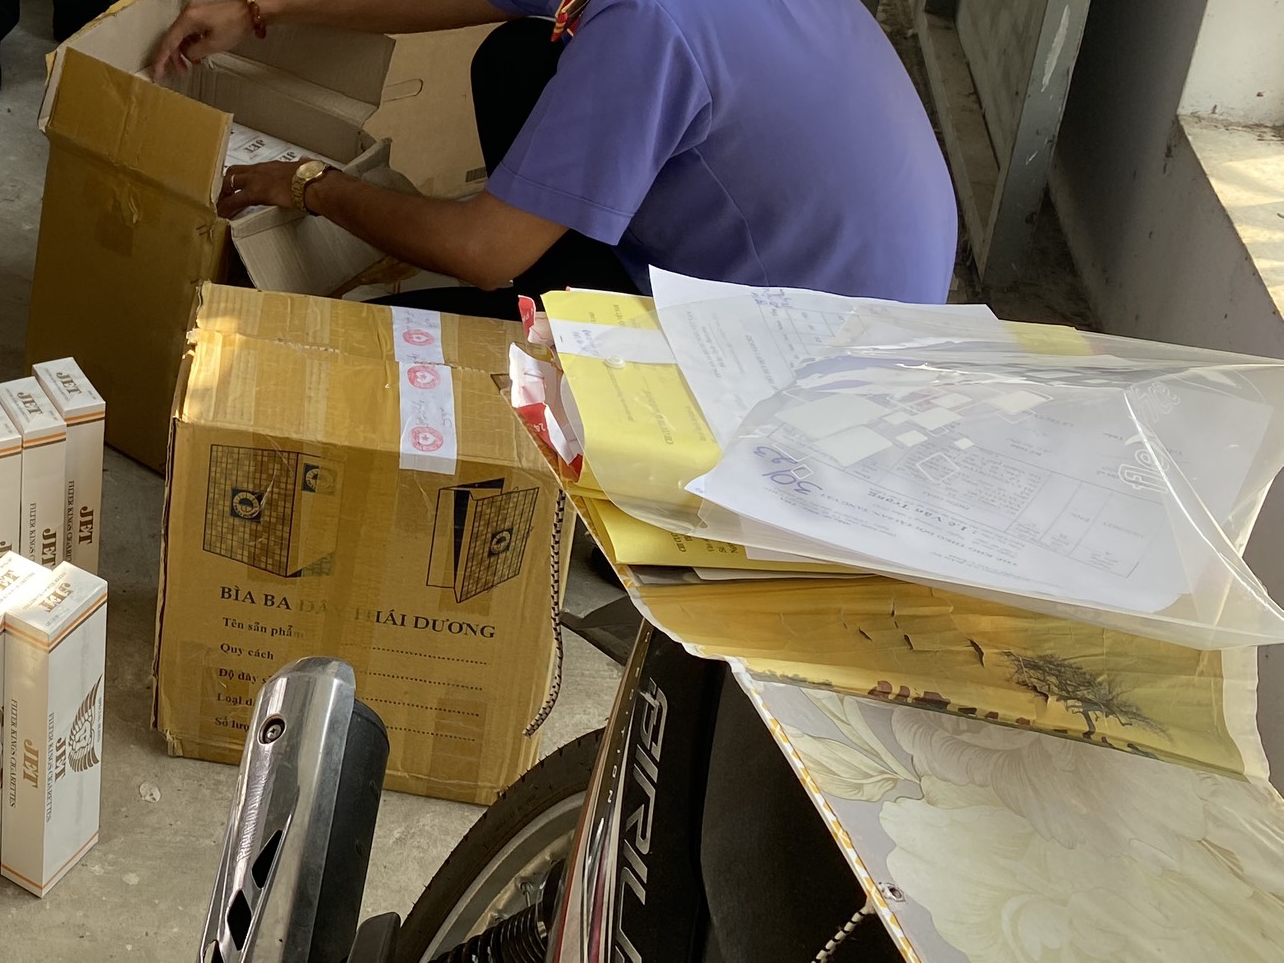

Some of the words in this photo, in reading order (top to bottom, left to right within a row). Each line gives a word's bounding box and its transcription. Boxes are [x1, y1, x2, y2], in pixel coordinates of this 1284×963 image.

[244, 139, 266, 154] JET
[279, 151, 296, 161] JE
[56, 371, 82, 396] JET
[17, 391, 43, 415] JET
[78, 505, 94, 545] JET
[42, 527, 57, 566] JET
[39, 583, 74, 613] JET
[219, 586, 259, 605] BÌA
[262, 593, 292, 610] BA
[413, 610, 496, 639] DƯƠNG
[222, 617, 244, 630] Tên
[220, 642, 245, 656] Quy
[248, 648, 274, 660] cách
[218, 668, 235, 680] Độ
[217, 693, 243, 706] Loại
[215, 717, 229, 727] Số
[231, 720, 250, 731] lượ
[23, 739, 39, 788] JET
[55, 737, 66, 783] JET
[46, 771, 54, 823] CIGARETTES
[616, 676, 668, 963] SIRIU
